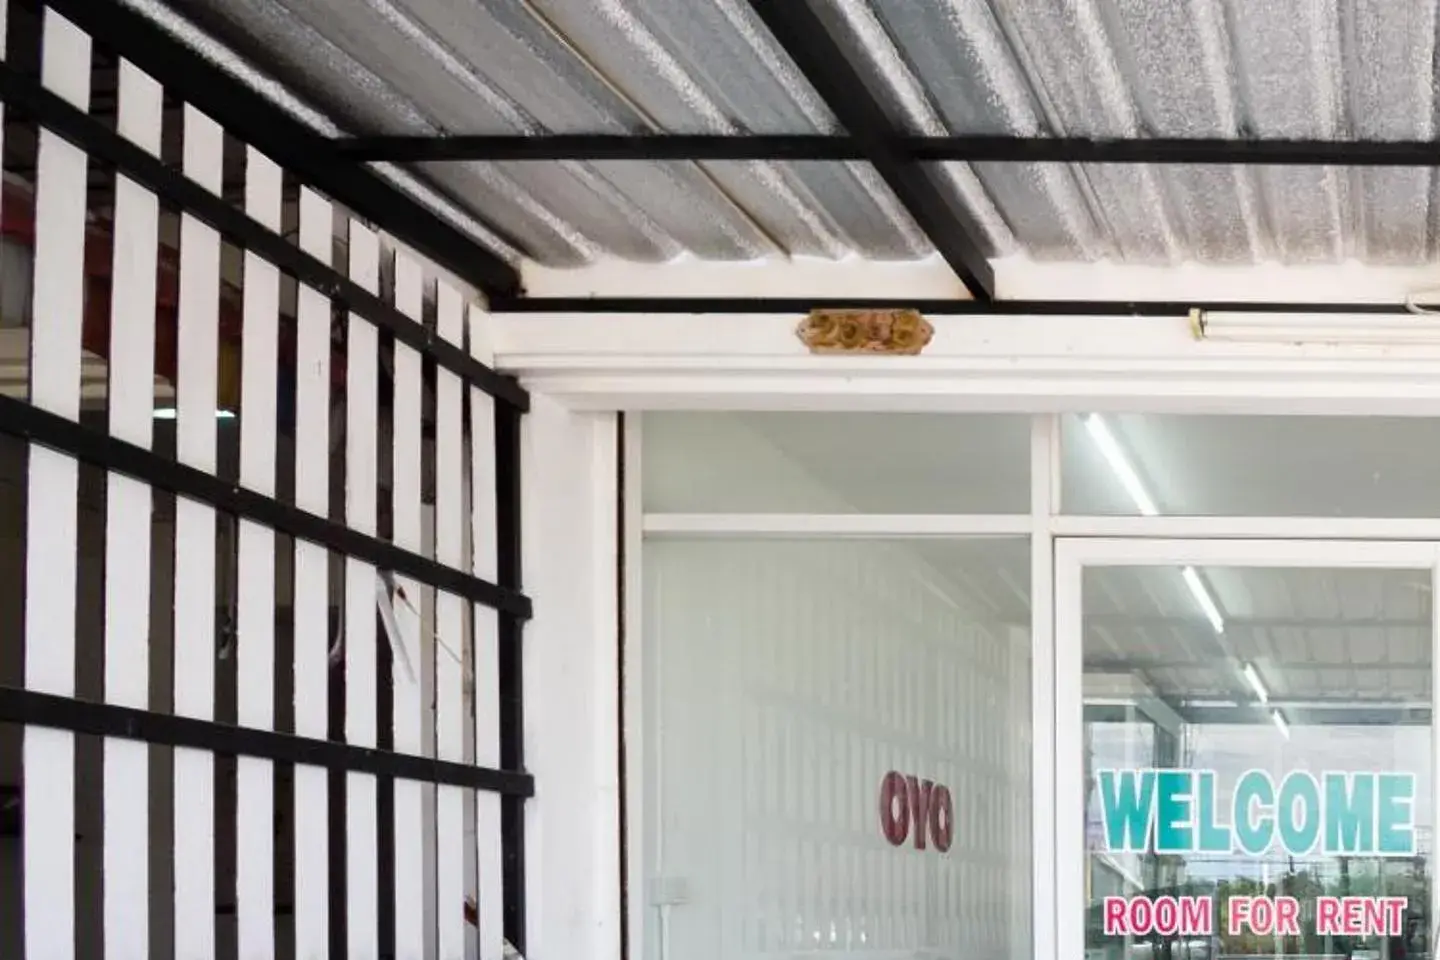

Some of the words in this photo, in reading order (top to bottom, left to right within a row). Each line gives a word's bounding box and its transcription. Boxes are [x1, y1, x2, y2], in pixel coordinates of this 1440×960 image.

[880, 770, 953, 853] OYO
[1099, 770, 1415, 855] WELCOME
[1104, 897, 1211, 934] ROOM
[1229, 897, 1300, 934] FOR
[1317, 897, 1407, 934] RENT
